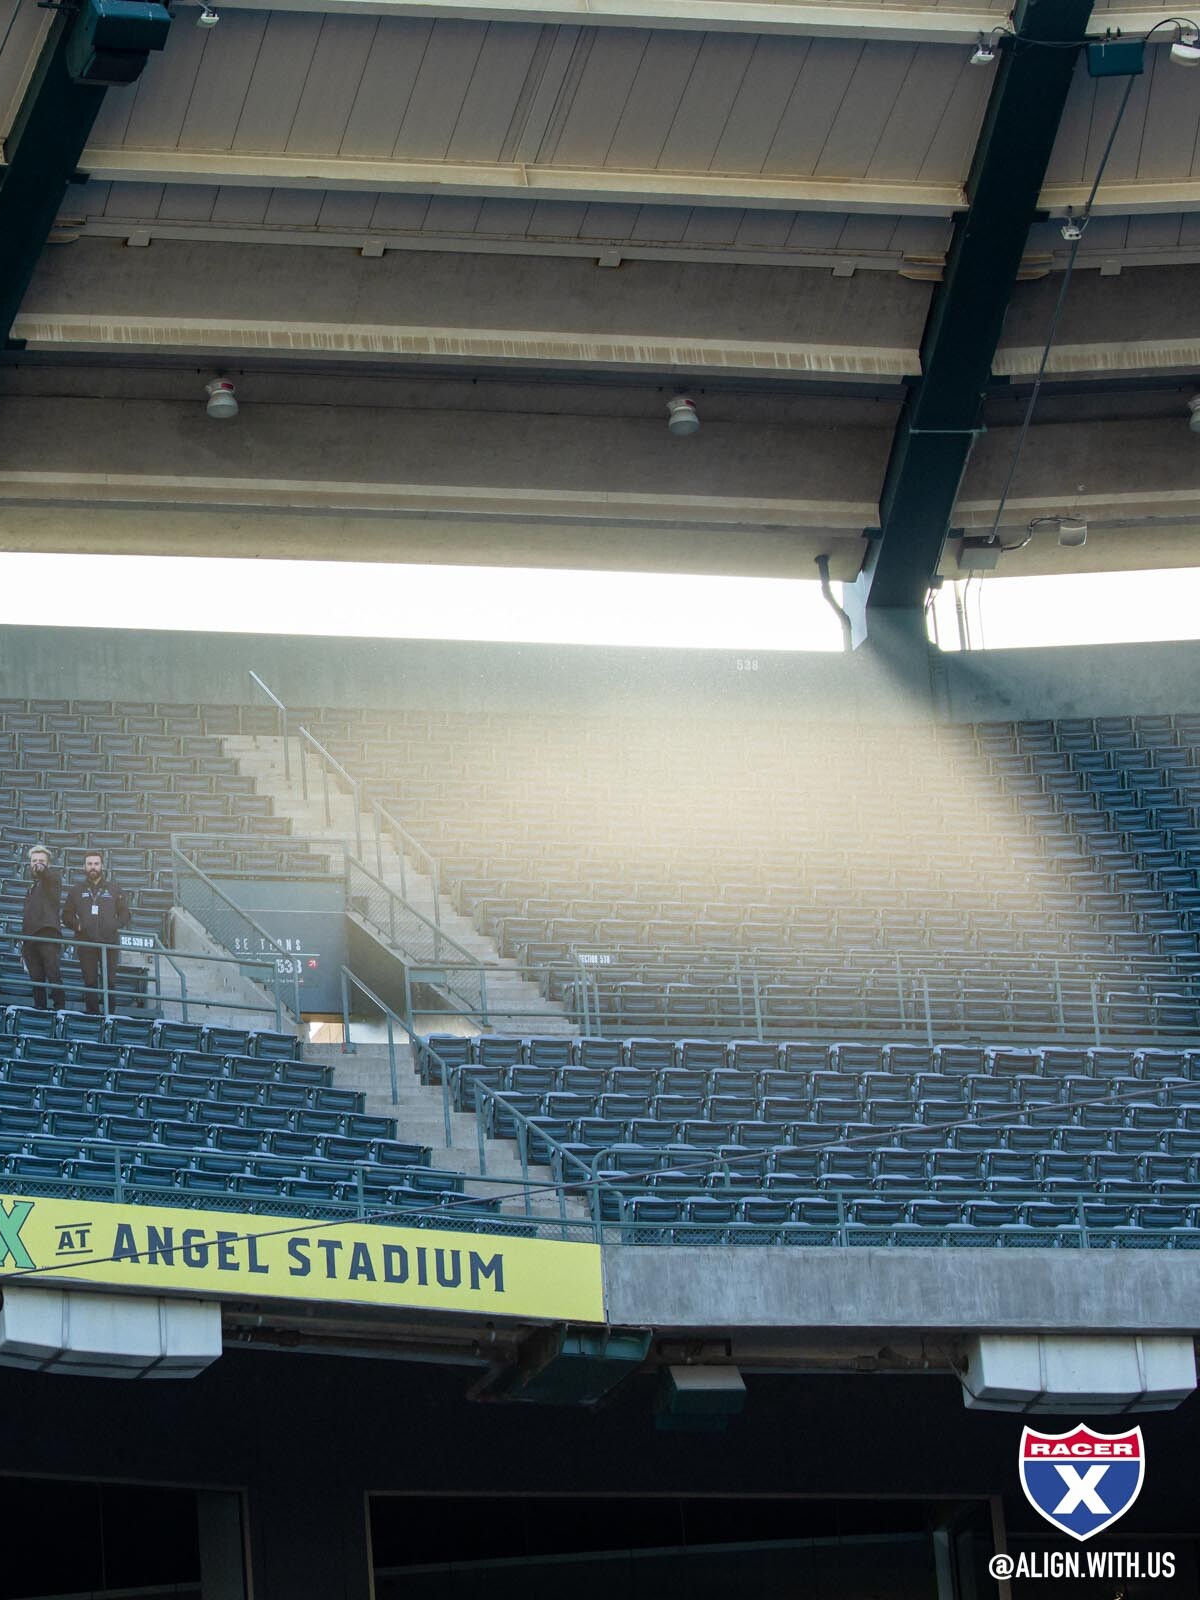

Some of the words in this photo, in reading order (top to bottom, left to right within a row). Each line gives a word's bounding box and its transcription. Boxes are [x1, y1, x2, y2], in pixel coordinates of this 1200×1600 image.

[235, 938, 301, 951] SETIONS
[58, 1229, 91, 1250] AT
[112, 1223, 270, 1274] ANGEL
[287, 1237, 506, 1293] STADIUM
